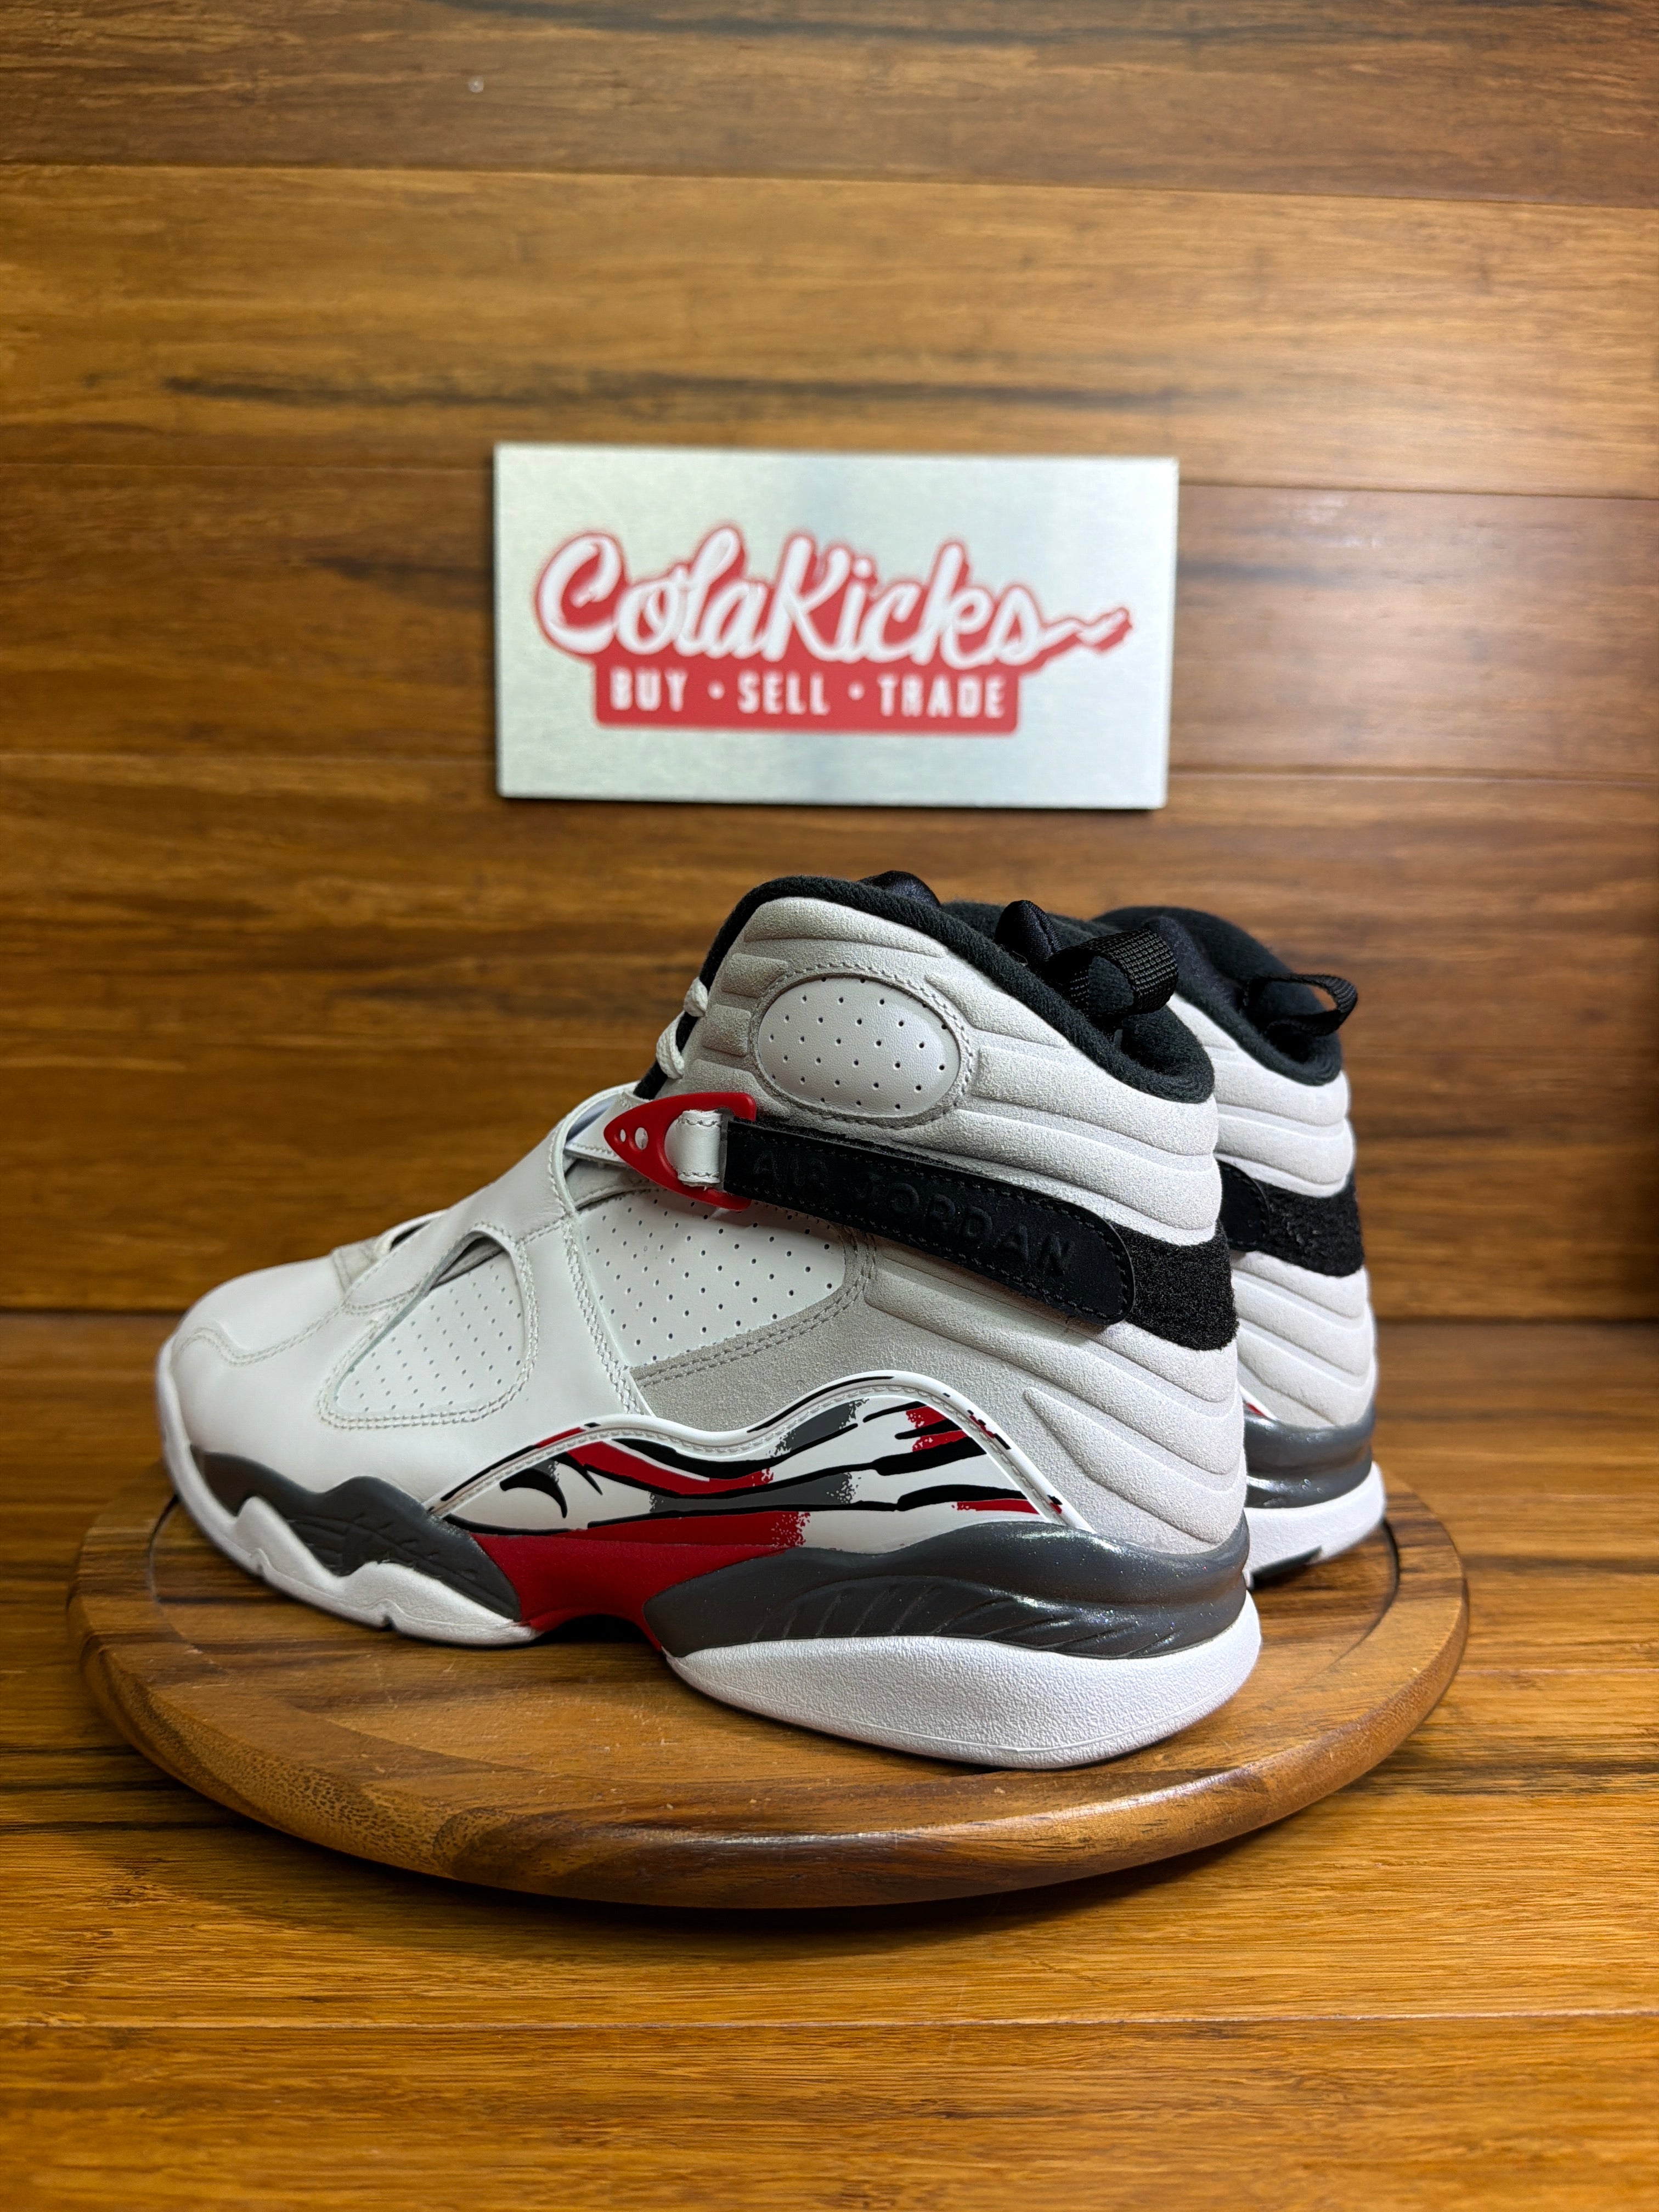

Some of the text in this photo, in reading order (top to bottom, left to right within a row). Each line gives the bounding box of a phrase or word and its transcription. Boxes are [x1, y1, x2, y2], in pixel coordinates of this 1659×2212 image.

[539, 526, 1131, 669] ColaKicks
[610, 665, 1006, 719] BUY SELL TRADE
[753, 1149, 1076, 1276] AIR JORDAN
